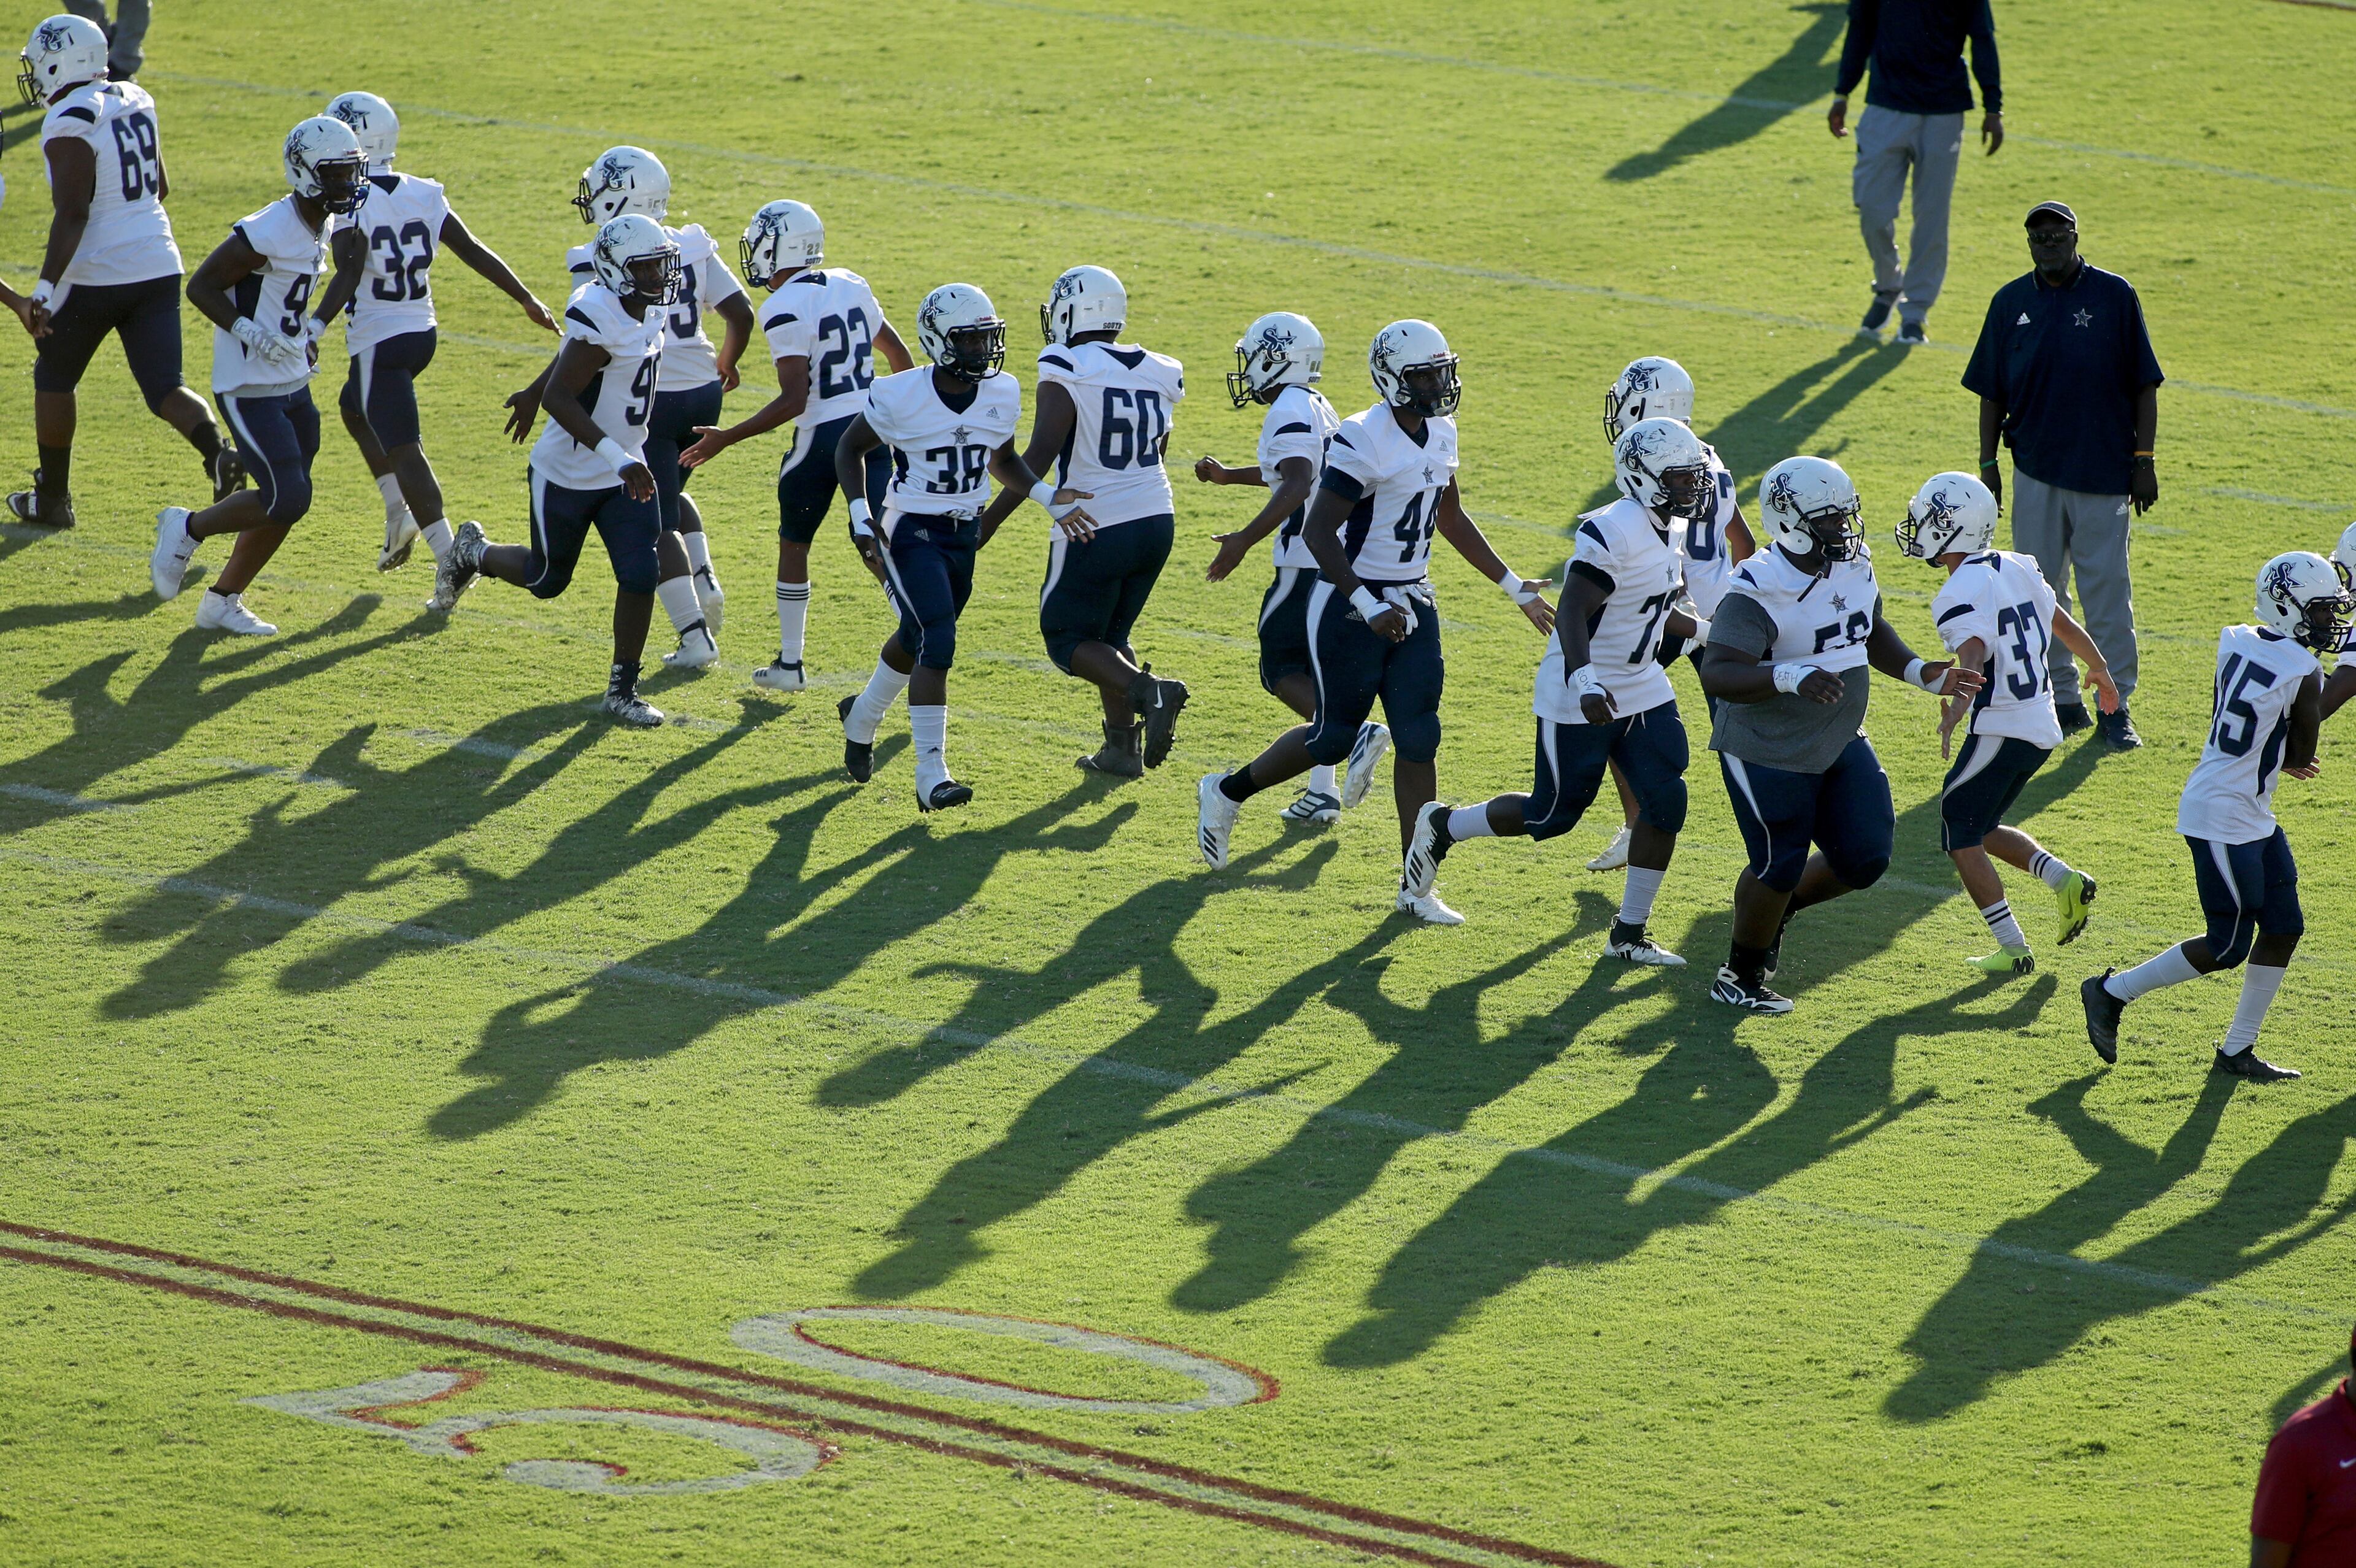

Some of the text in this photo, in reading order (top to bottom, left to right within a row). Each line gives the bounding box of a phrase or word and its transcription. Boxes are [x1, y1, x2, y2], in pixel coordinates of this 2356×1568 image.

[112, 112, 158, 201] 69
[371, 221, 433, 301] 32
[807, 242, 821, 255] 22
[280, 274, 320, 337] 9
[625, 351, 661, 426] 9
[819, 307, 874, 399] 22
[926, 444, 987, 494] 38
[1099, 387, 1165, 471] 60
[1998, 600, 2048, 700] 37
[2209, 652, 2277, 758] 15
